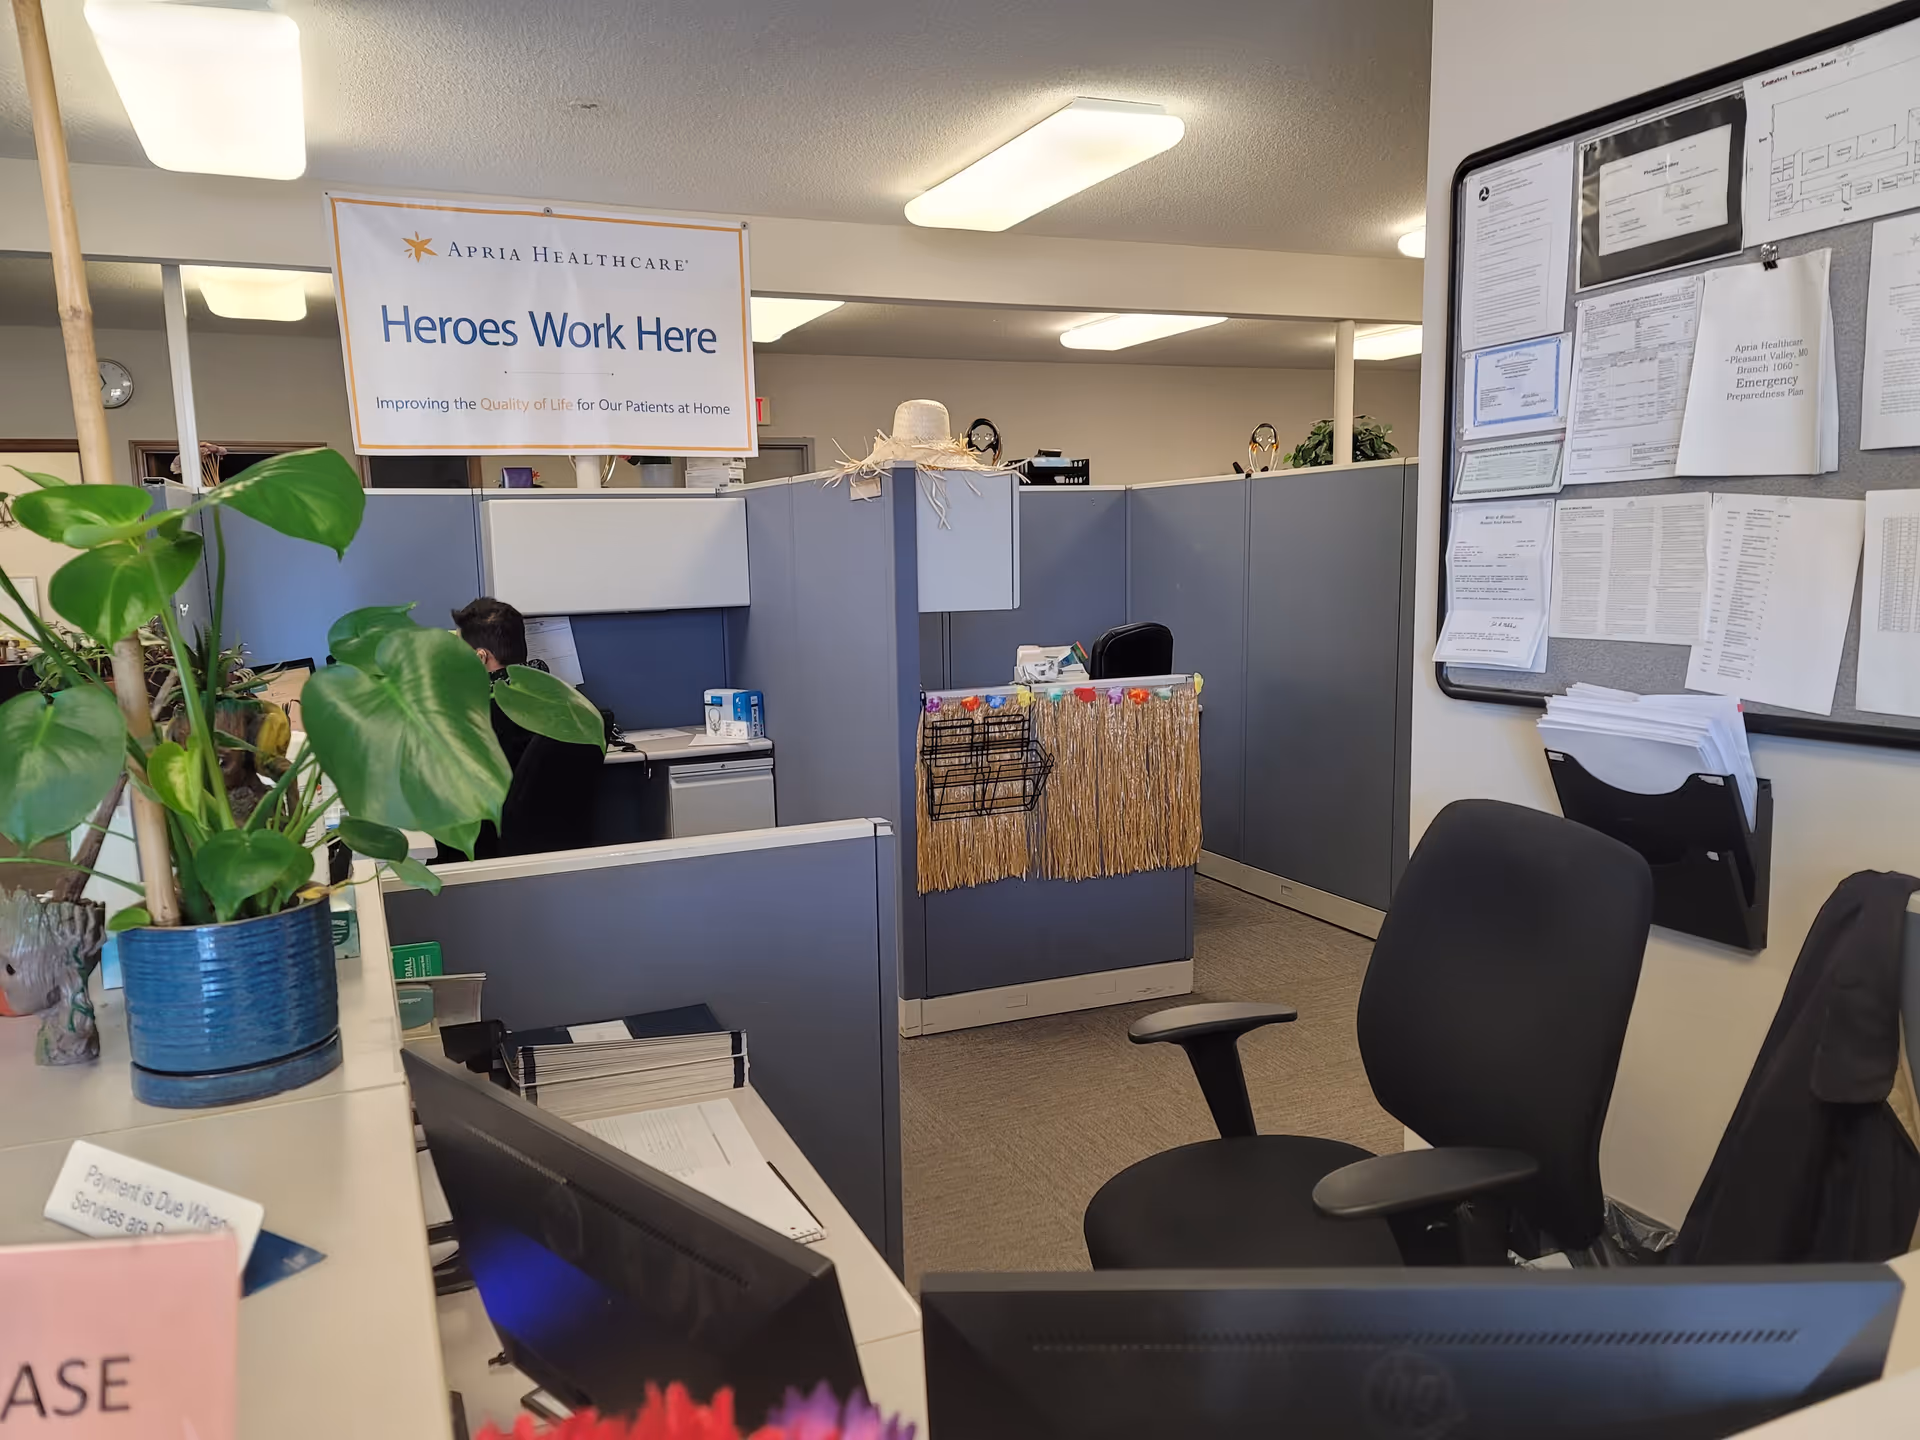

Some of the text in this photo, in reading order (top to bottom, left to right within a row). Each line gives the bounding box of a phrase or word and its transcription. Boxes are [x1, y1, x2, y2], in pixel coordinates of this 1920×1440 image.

[448, 241, 686, 272] APRIA HEALTHCARE
[381, 305, 717, 354] Heroes Work Here
[1735, 339, 1803, 354] Apria Healthcare
[1736, 364, 1769, 374] Branch
[1736, 376, 1798, 388] Emergency
[376, 396, 731, 415] Improving the Quality of Life for Our Patients at Home
[1726, 388, 1804, 402] Preparedness Plan
[84, 1164, 141, 1202] Payment
[142, 1184, 154, 1207] is
[154, 1191, 184, 1219] Due
[71, 1190, 124, 1229] Services
[125, 1216, 149, 1236] are
[0, 1354, 131, 1421] ASE
